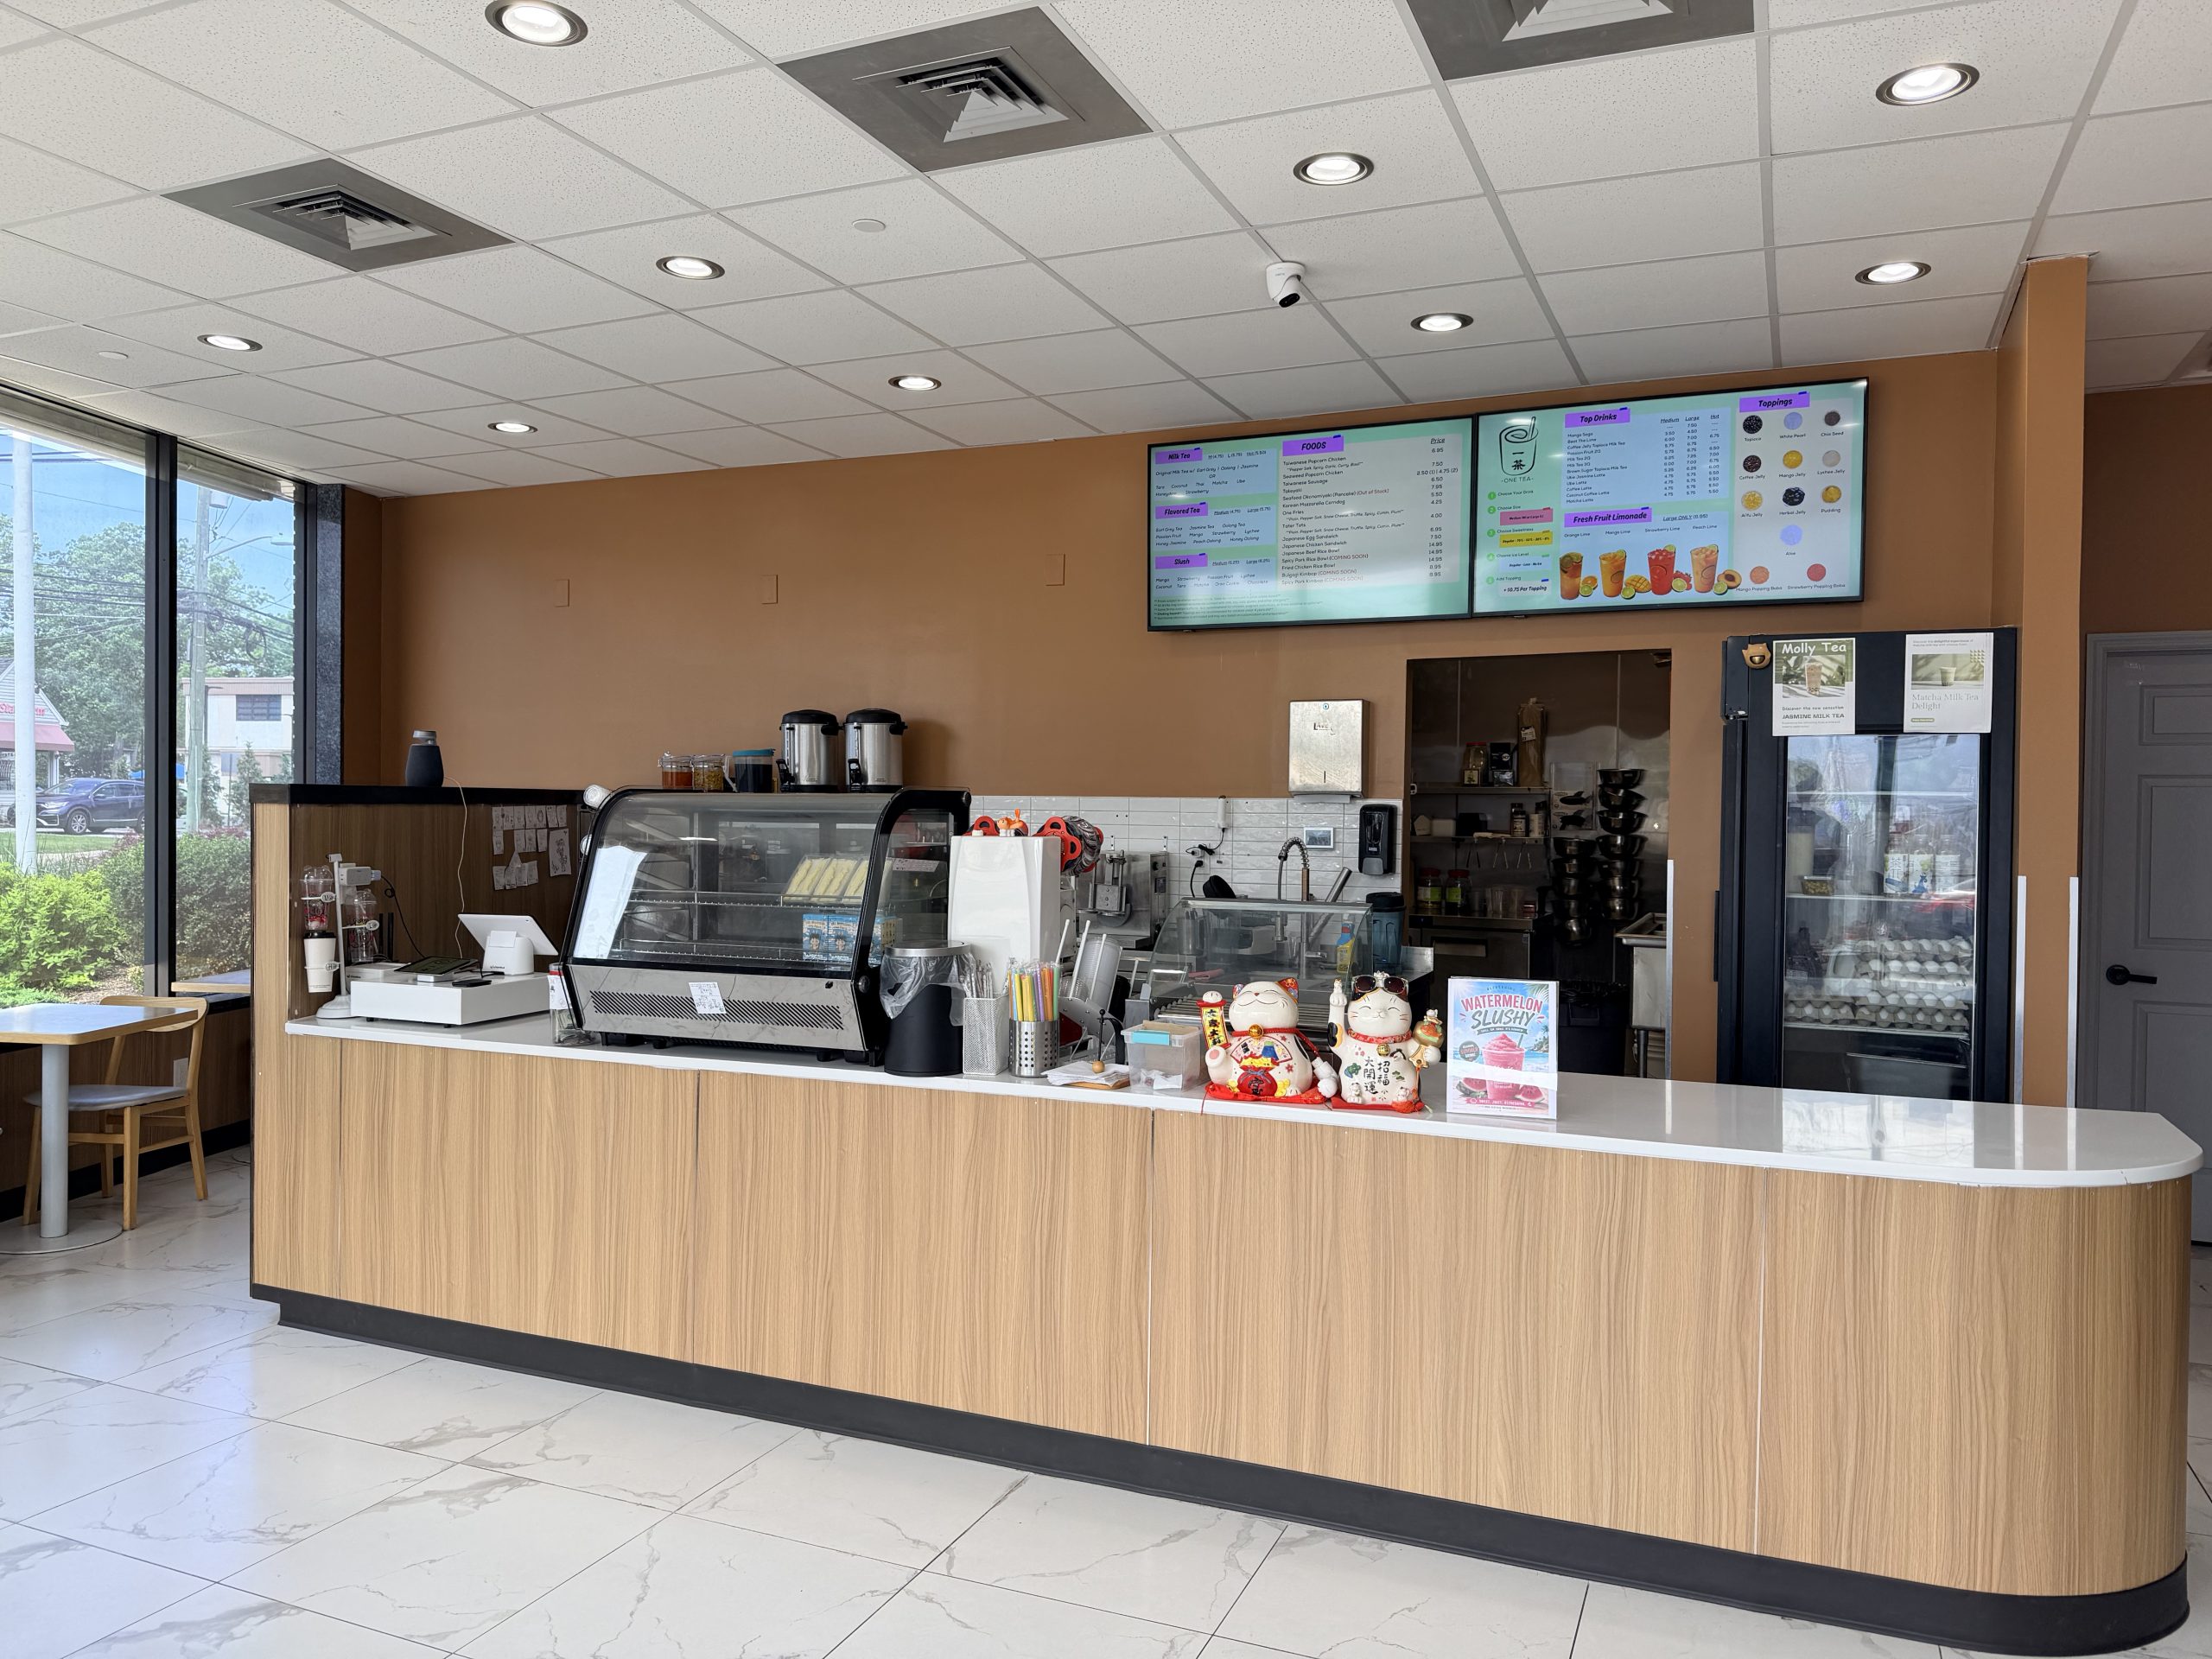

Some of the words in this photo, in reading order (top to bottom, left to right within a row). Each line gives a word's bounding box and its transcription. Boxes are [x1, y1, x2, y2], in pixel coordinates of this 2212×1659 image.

[1758, 397, 1792, 408] Toppings
[1580, 415, 1593, 424] Top
[1593, 413, 1617, 422] Drinks
[1301, 441, 1326, 451] FOODS
[1511, 451, 1526, 470] 一茶
[1164, 507, 1190, 515] Flavored
[1573, 515, 1593, 523] Fresh
[1593, 513, 1611, 522] Fruit
[1612, 511, 1647, 521] Limonade
[1781, 642, 1816, 656] Molly
[1821, 642, 1847, 652] Tea
[1911, 702, 1941, 711] Delight
[1461, 994, 1543, 1013] WATERMELON
[1471, 1009, 1535, 1029] SLUSHY
[1363, 1056, 1379, 1094] 大開運
